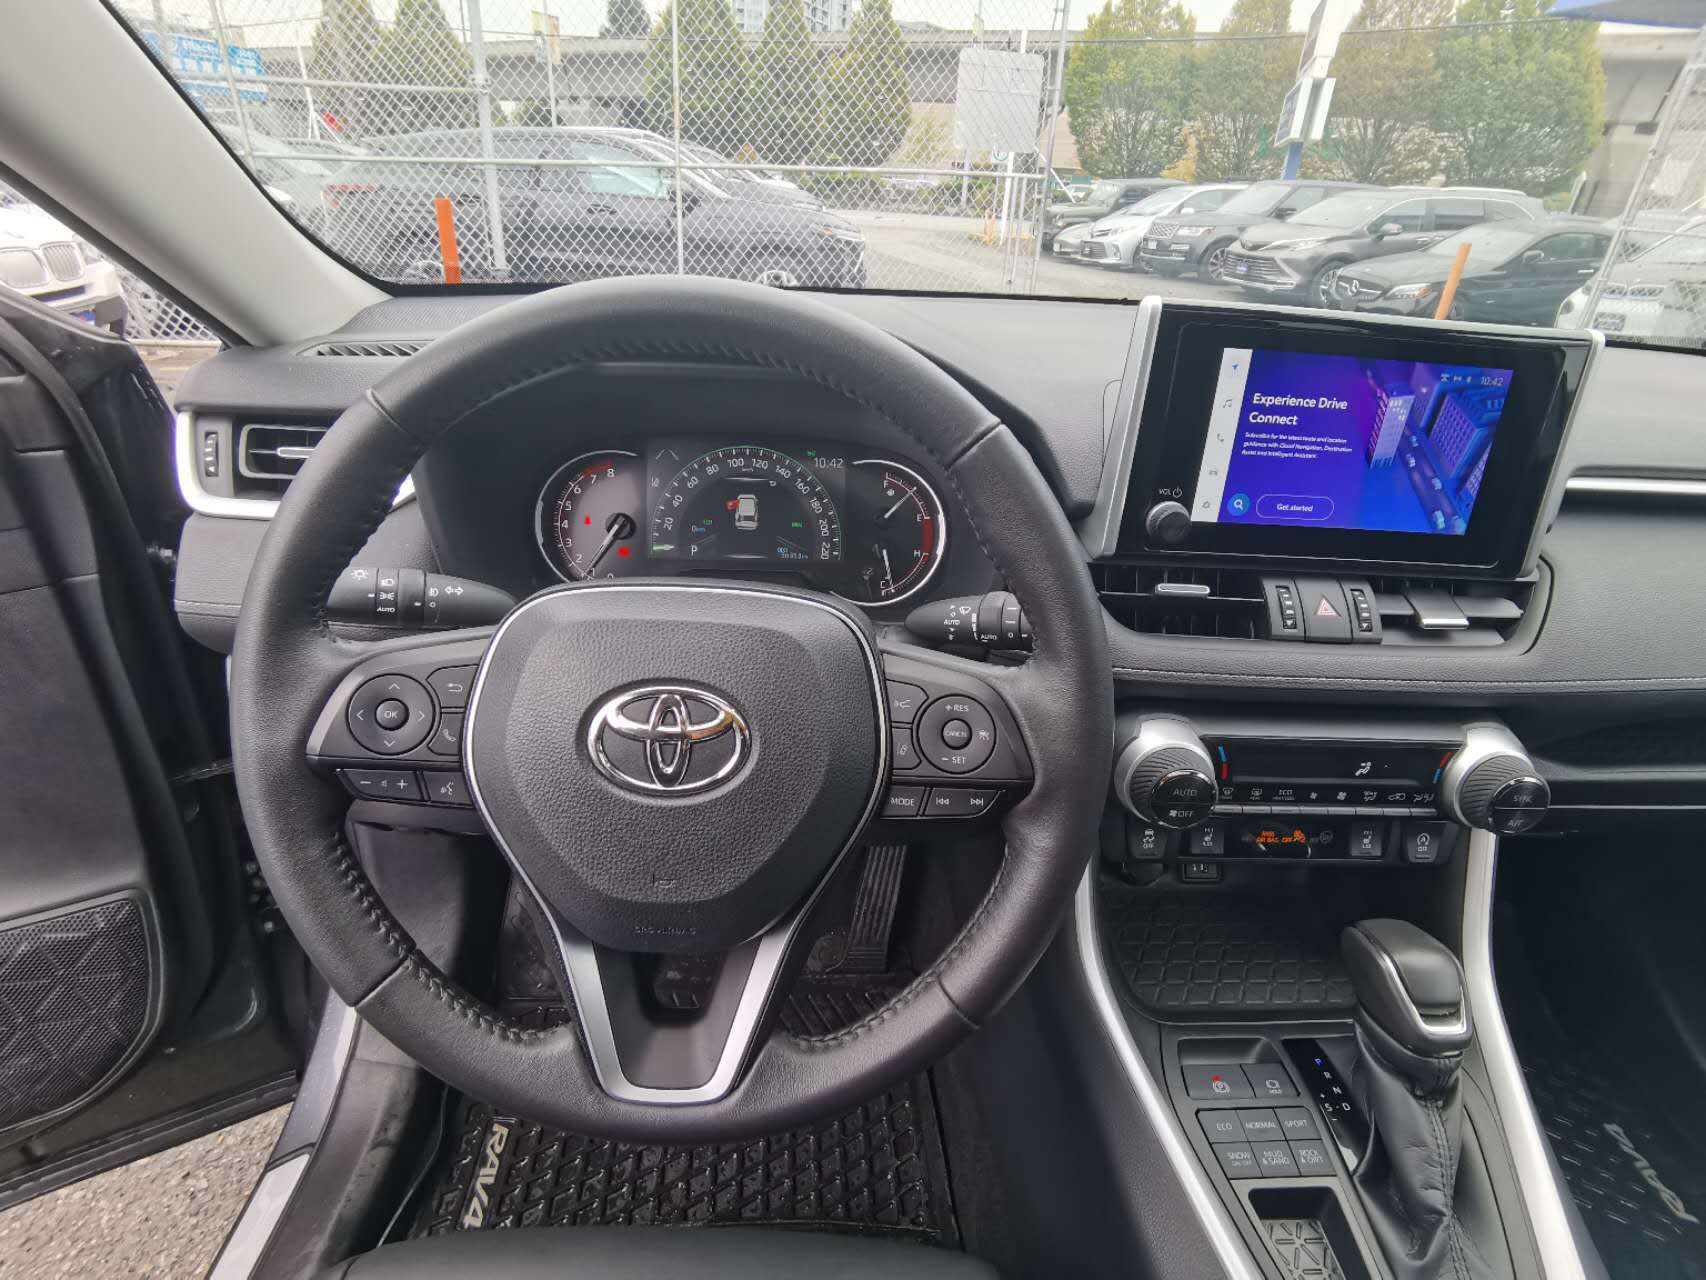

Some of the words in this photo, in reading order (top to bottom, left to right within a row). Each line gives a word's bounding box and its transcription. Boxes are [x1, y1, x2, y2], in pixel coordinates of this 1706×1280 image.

[1481, 376, 1504, 386] 10:42
[1253, 392, 1317, 407] Experience
[1318, 397, 1348, 410] Drive
[1249, 411, 1298, 425] Connect
[727, 457, 744, 468] 100
[752, 458, 768, 470] 120
[814, 457, 845, 469] 10:42
[607, 468, 615, 478] 8
[705, 463, 720, 476] 80
[775, 464, 792, 479] 140
[590, 474, 597, 484] 7
[686, 476, 699, 489] 60
[573, 484, 582, 494] 6
[794, 477, 810, 495] 160
[883, 480, 890, 489] F
[564, 501, 572, 511] 5
[672, 494, 683, 508] 40
[809, 497, 823, 514] 180
[1277, 503, 1289, 511] Get
[1290, 504, 1313, 512] started
[916, 513, 923, 522] E
[561, 519, 569, 529] 4
[663, 516, 674, 531] 20
[819, 519, 830, 537] 200
[565, 538, 573, 547] 3
[690, 545, 698, 556] P
[820, 541, 831, 560] 220
[913, 549, 921, 557] H
[575, 553, 583, 563] 2
[943, 618, 961, 626] AUTO
[980, 633, 998, 641] AUTO
[384, 709, 399, 719] OK
[952, 756, 967, 765] SET
[1172, 788, 1198, 797] AUTO
[890, 797, 915, 806] MODE
[1177, 810, 1194, 818] OFF
[1314, 1057, 1323, 1066] P
[1323, 1071, 1333, 1079] R
[1332, 1086, 1342, 1094] N
[1324, 1103, 1334, 1112] S
[1216, 1122, 1233, 1131] ECO
[1245, 1120, 1278, 1129] NORMAL
[1284, 1119, 1308, 1128] SPORT
[1227, 1151, 1251, 1160] SNOW
[463, 1122, 510, 1230] RAV4
[1603, 1122, 1700, 1223] RAV4
